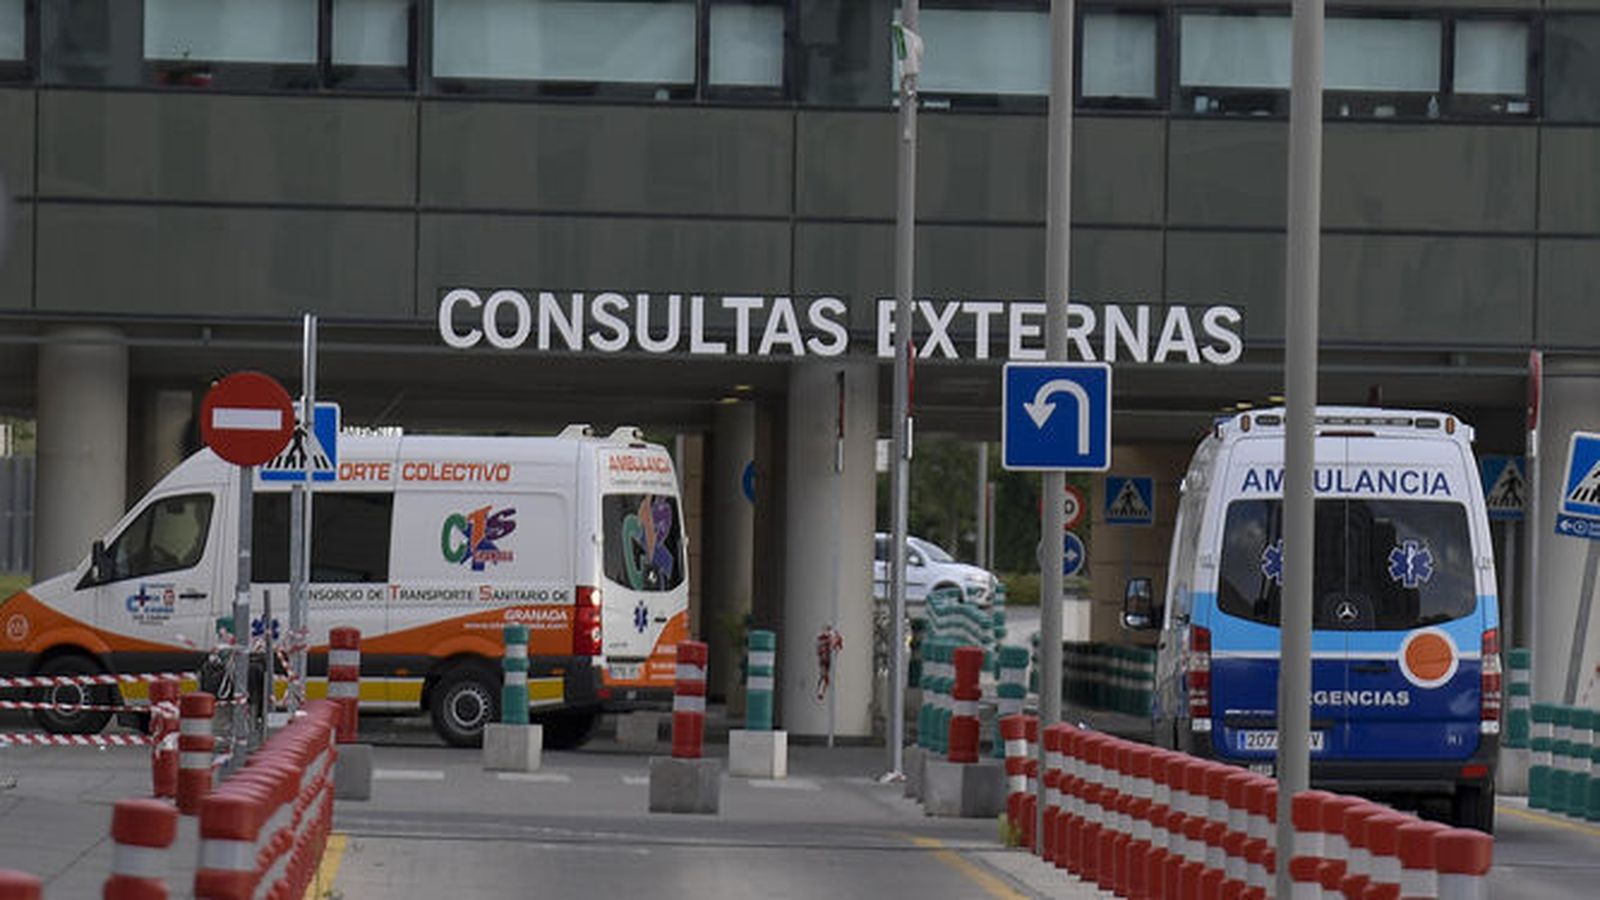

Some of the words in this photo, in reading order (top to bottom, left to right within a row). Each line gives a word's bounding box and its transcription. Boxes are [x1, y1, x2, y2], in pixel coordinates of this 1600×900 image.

[438, 289, 848, 357] CONSULTAS
[877, 299, 1244, 366] EXTERNAS
[402, 462, 511, 481] COLECTIVO
[1241, 468, 1452, 497] AMULANCIA
[308, 589, 363, 602] NSORCIO
[389, 584, 473, 601] TRANSPORTE
[479, 584, 549, 602] SANITARIO
[551, 589, 570, 602] DE
[504, 608, 568, 621] GRANADA
[1308, 690, 1411, 706] GENCIAS
[1247, 733, 1277, 749] 207
